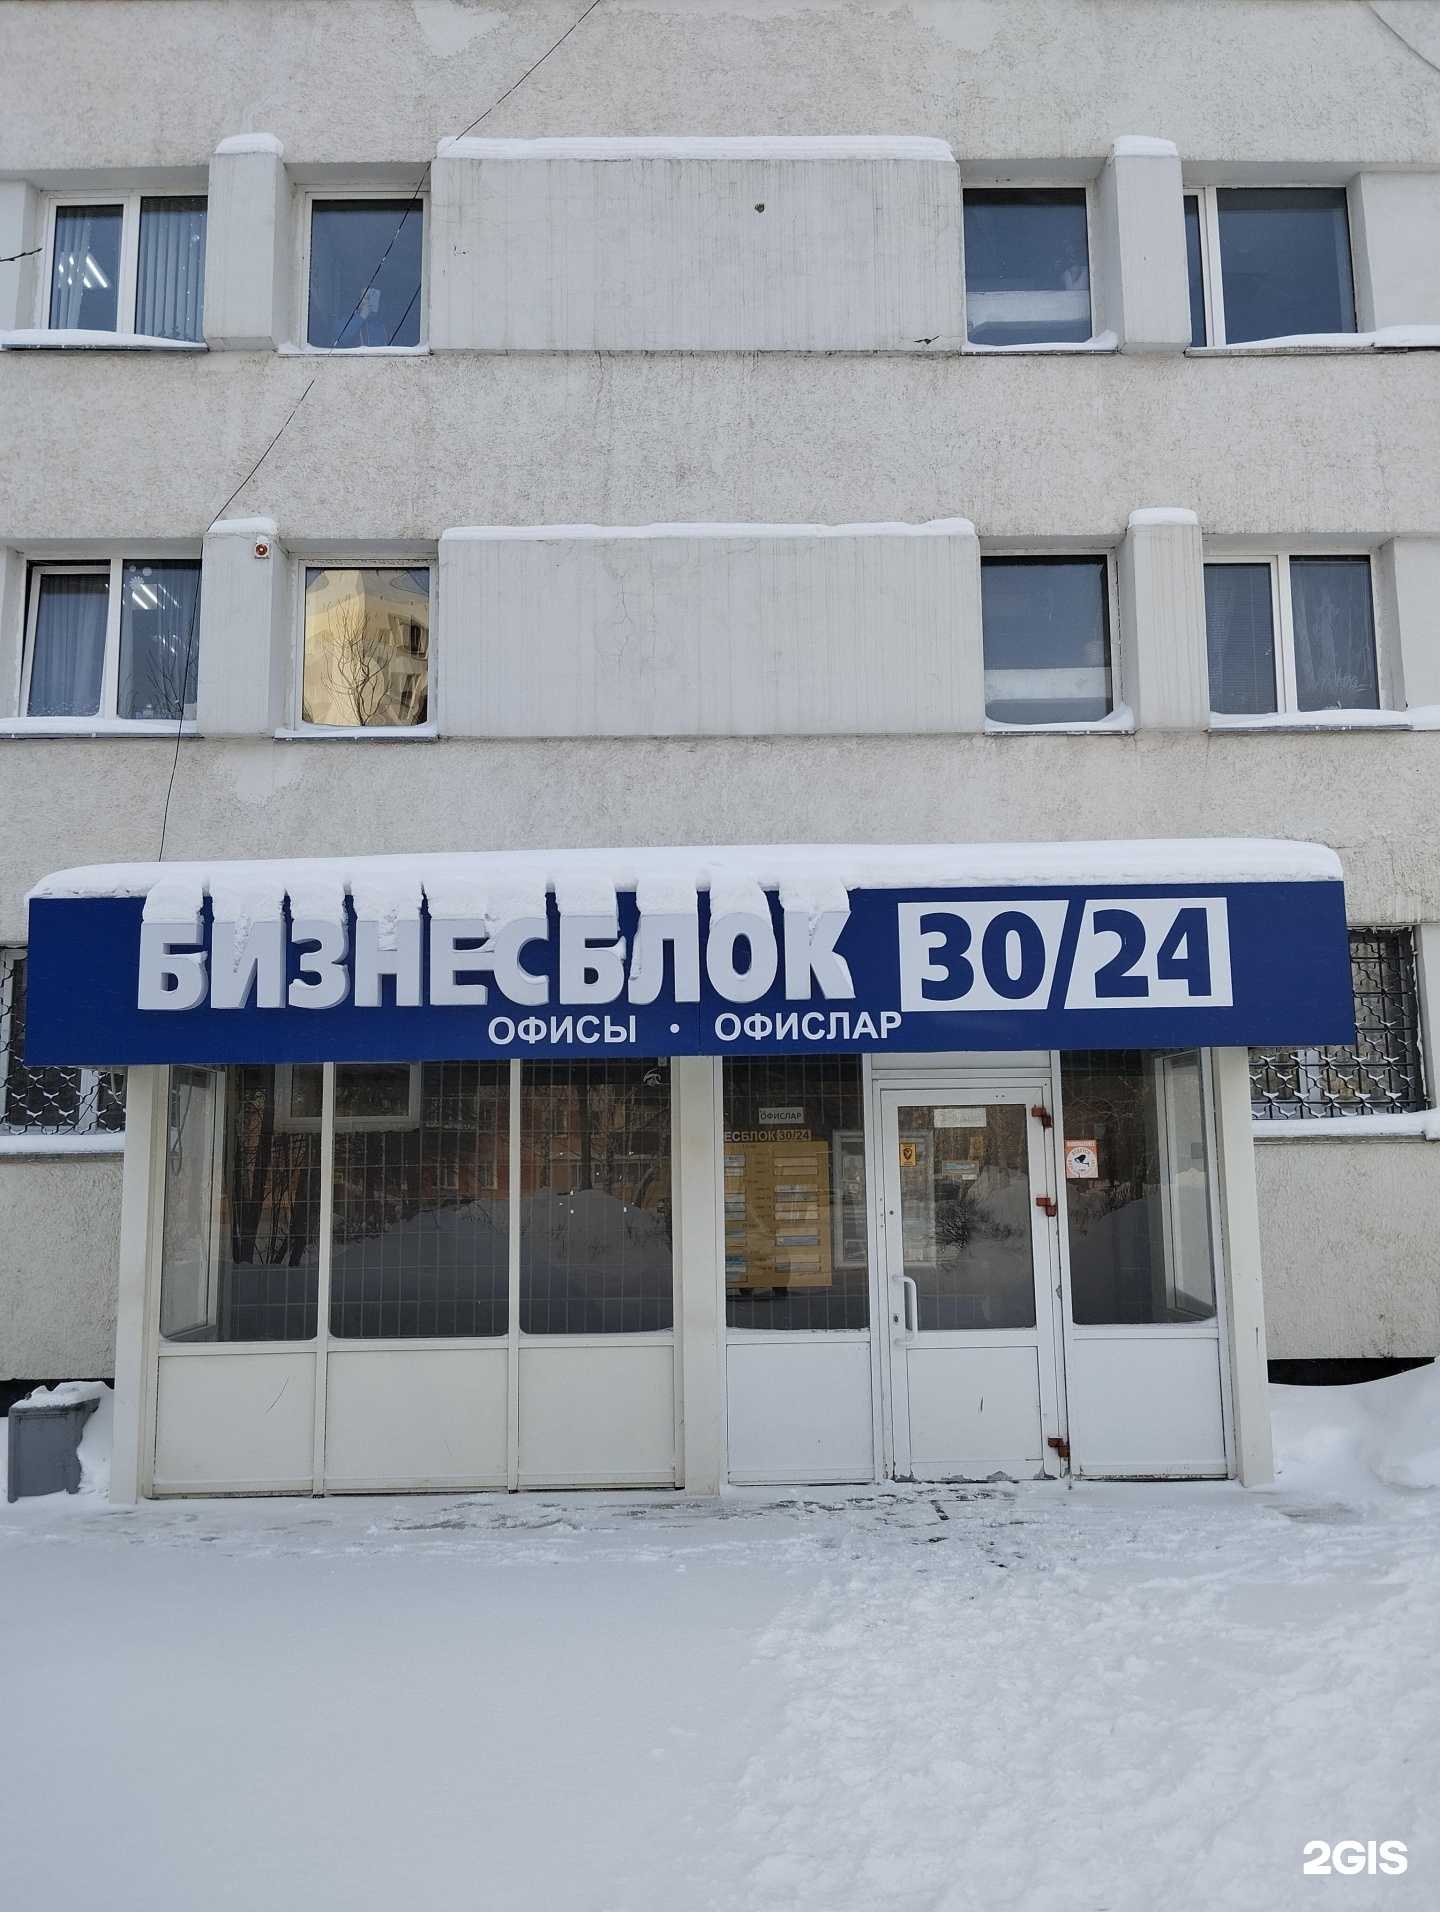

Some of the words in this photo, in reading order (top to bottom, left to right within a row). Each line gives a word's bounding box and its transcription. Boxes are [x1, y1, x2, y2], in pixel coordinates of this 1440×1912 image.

[137, 909, 856, 1011] БИЗНЕСБЛОК
[918, 899, 1213, 1009] 30/24
[488, 1014, 637, 1045] ОФИСЫ
[714, 1010, 902, 1042] ОФИСЛАР
[760, 1110, 802, 1121] ОФИСЛАР
